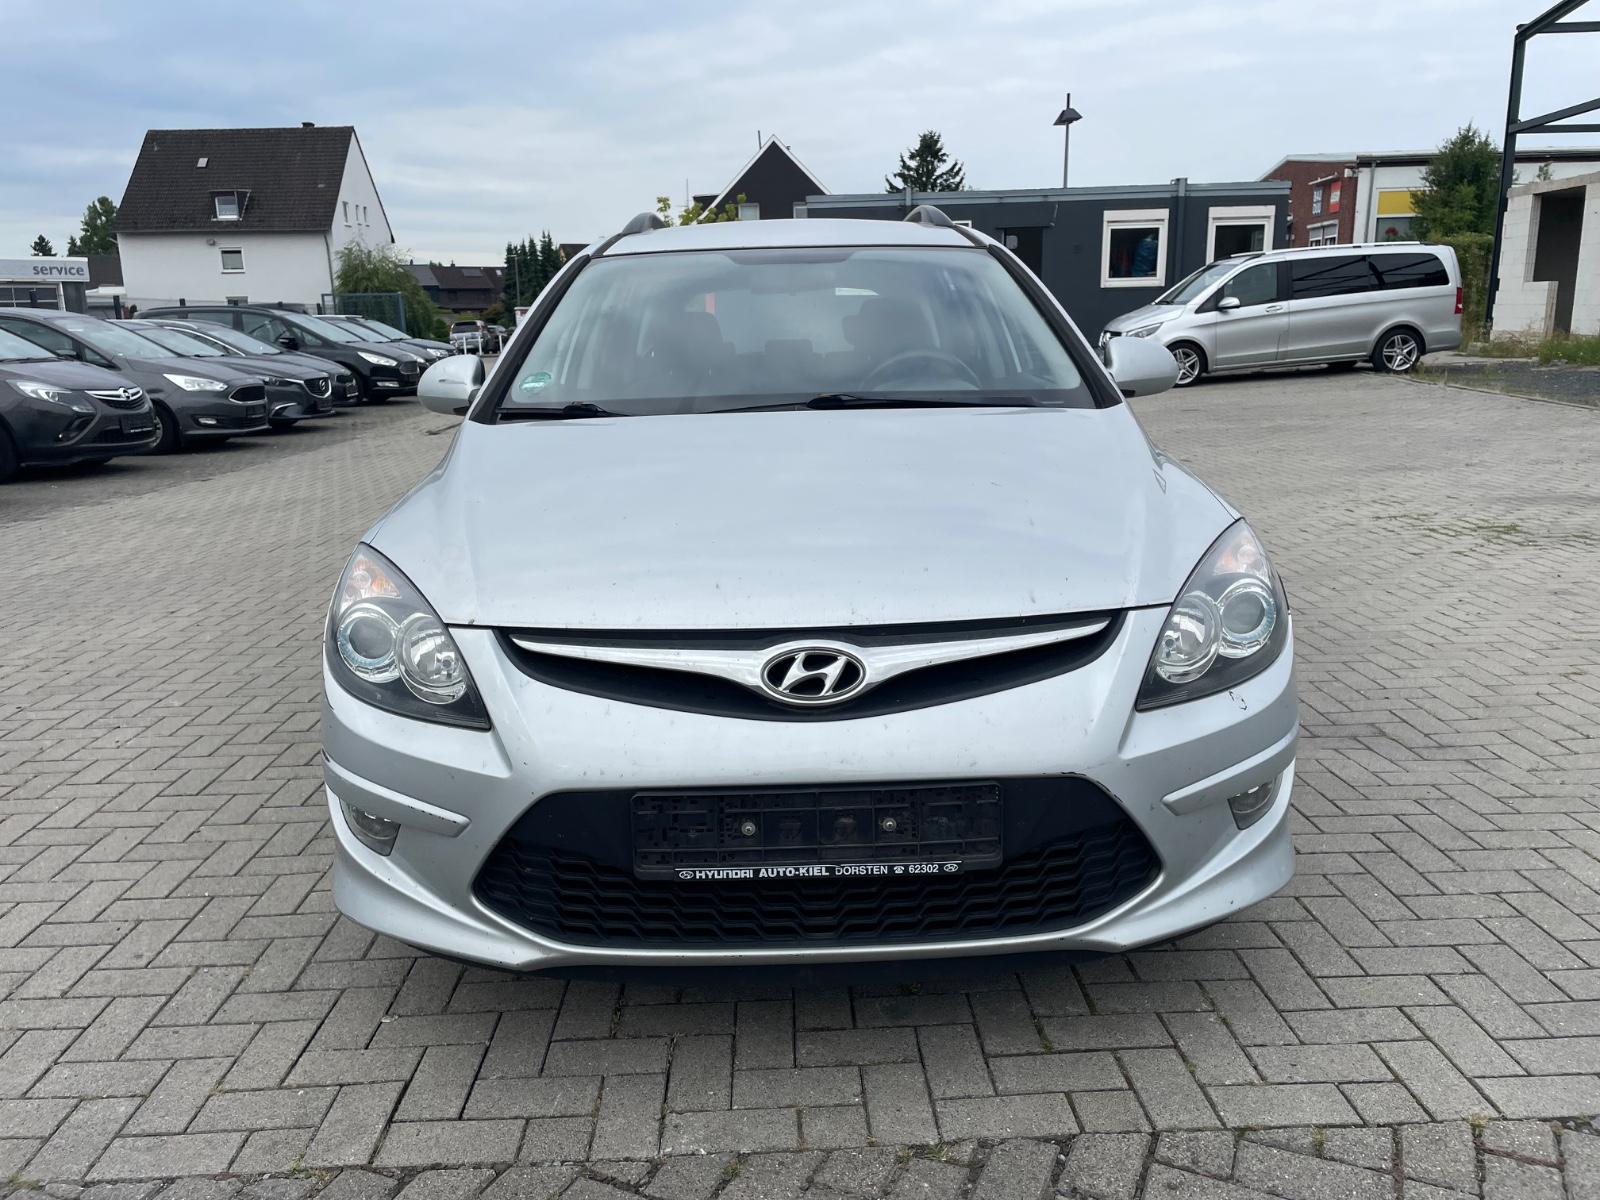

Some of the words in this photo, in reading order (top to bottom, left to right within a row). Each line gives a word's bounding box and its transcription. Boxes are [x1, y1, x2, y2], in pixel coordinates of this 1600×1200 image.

[33, 265, 85, 276] service
[696, 869, 753, 879] HYUNDAI
[758, 866, 830, 878] AUTO-KIEL
[835, 865, 888, 875] DORSTEN
[908, 864, 939, 874] 62302
